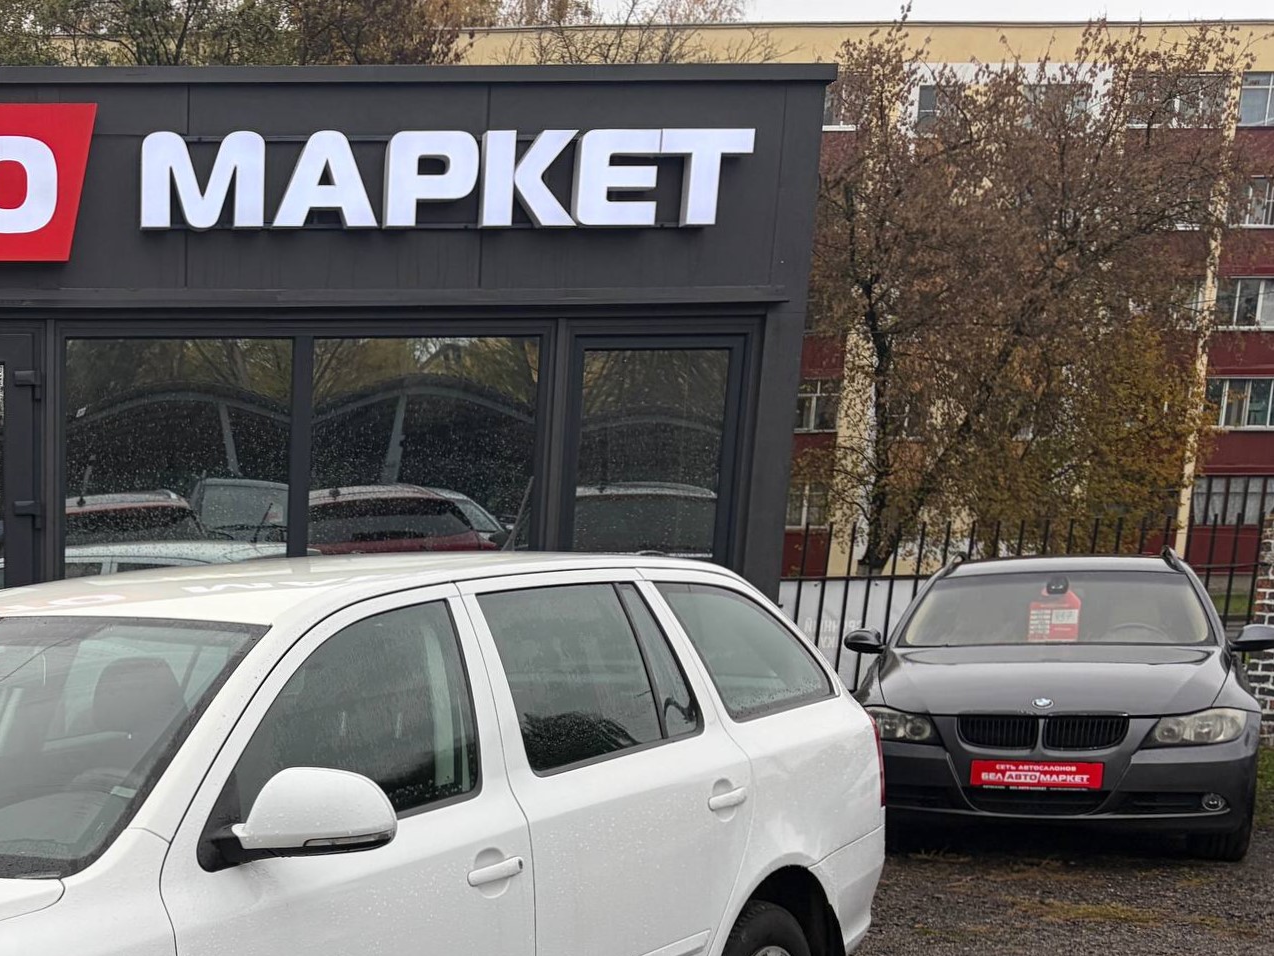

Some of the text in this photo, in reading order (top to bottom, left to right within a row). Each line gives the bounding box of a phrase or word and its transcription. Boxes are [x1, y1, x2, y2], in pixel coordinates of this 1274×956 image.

[140, 128, 755, 230] МАРКЕТ
[981, 772, 1090, 783] БЕЛ АВТО МАРКЕТ
